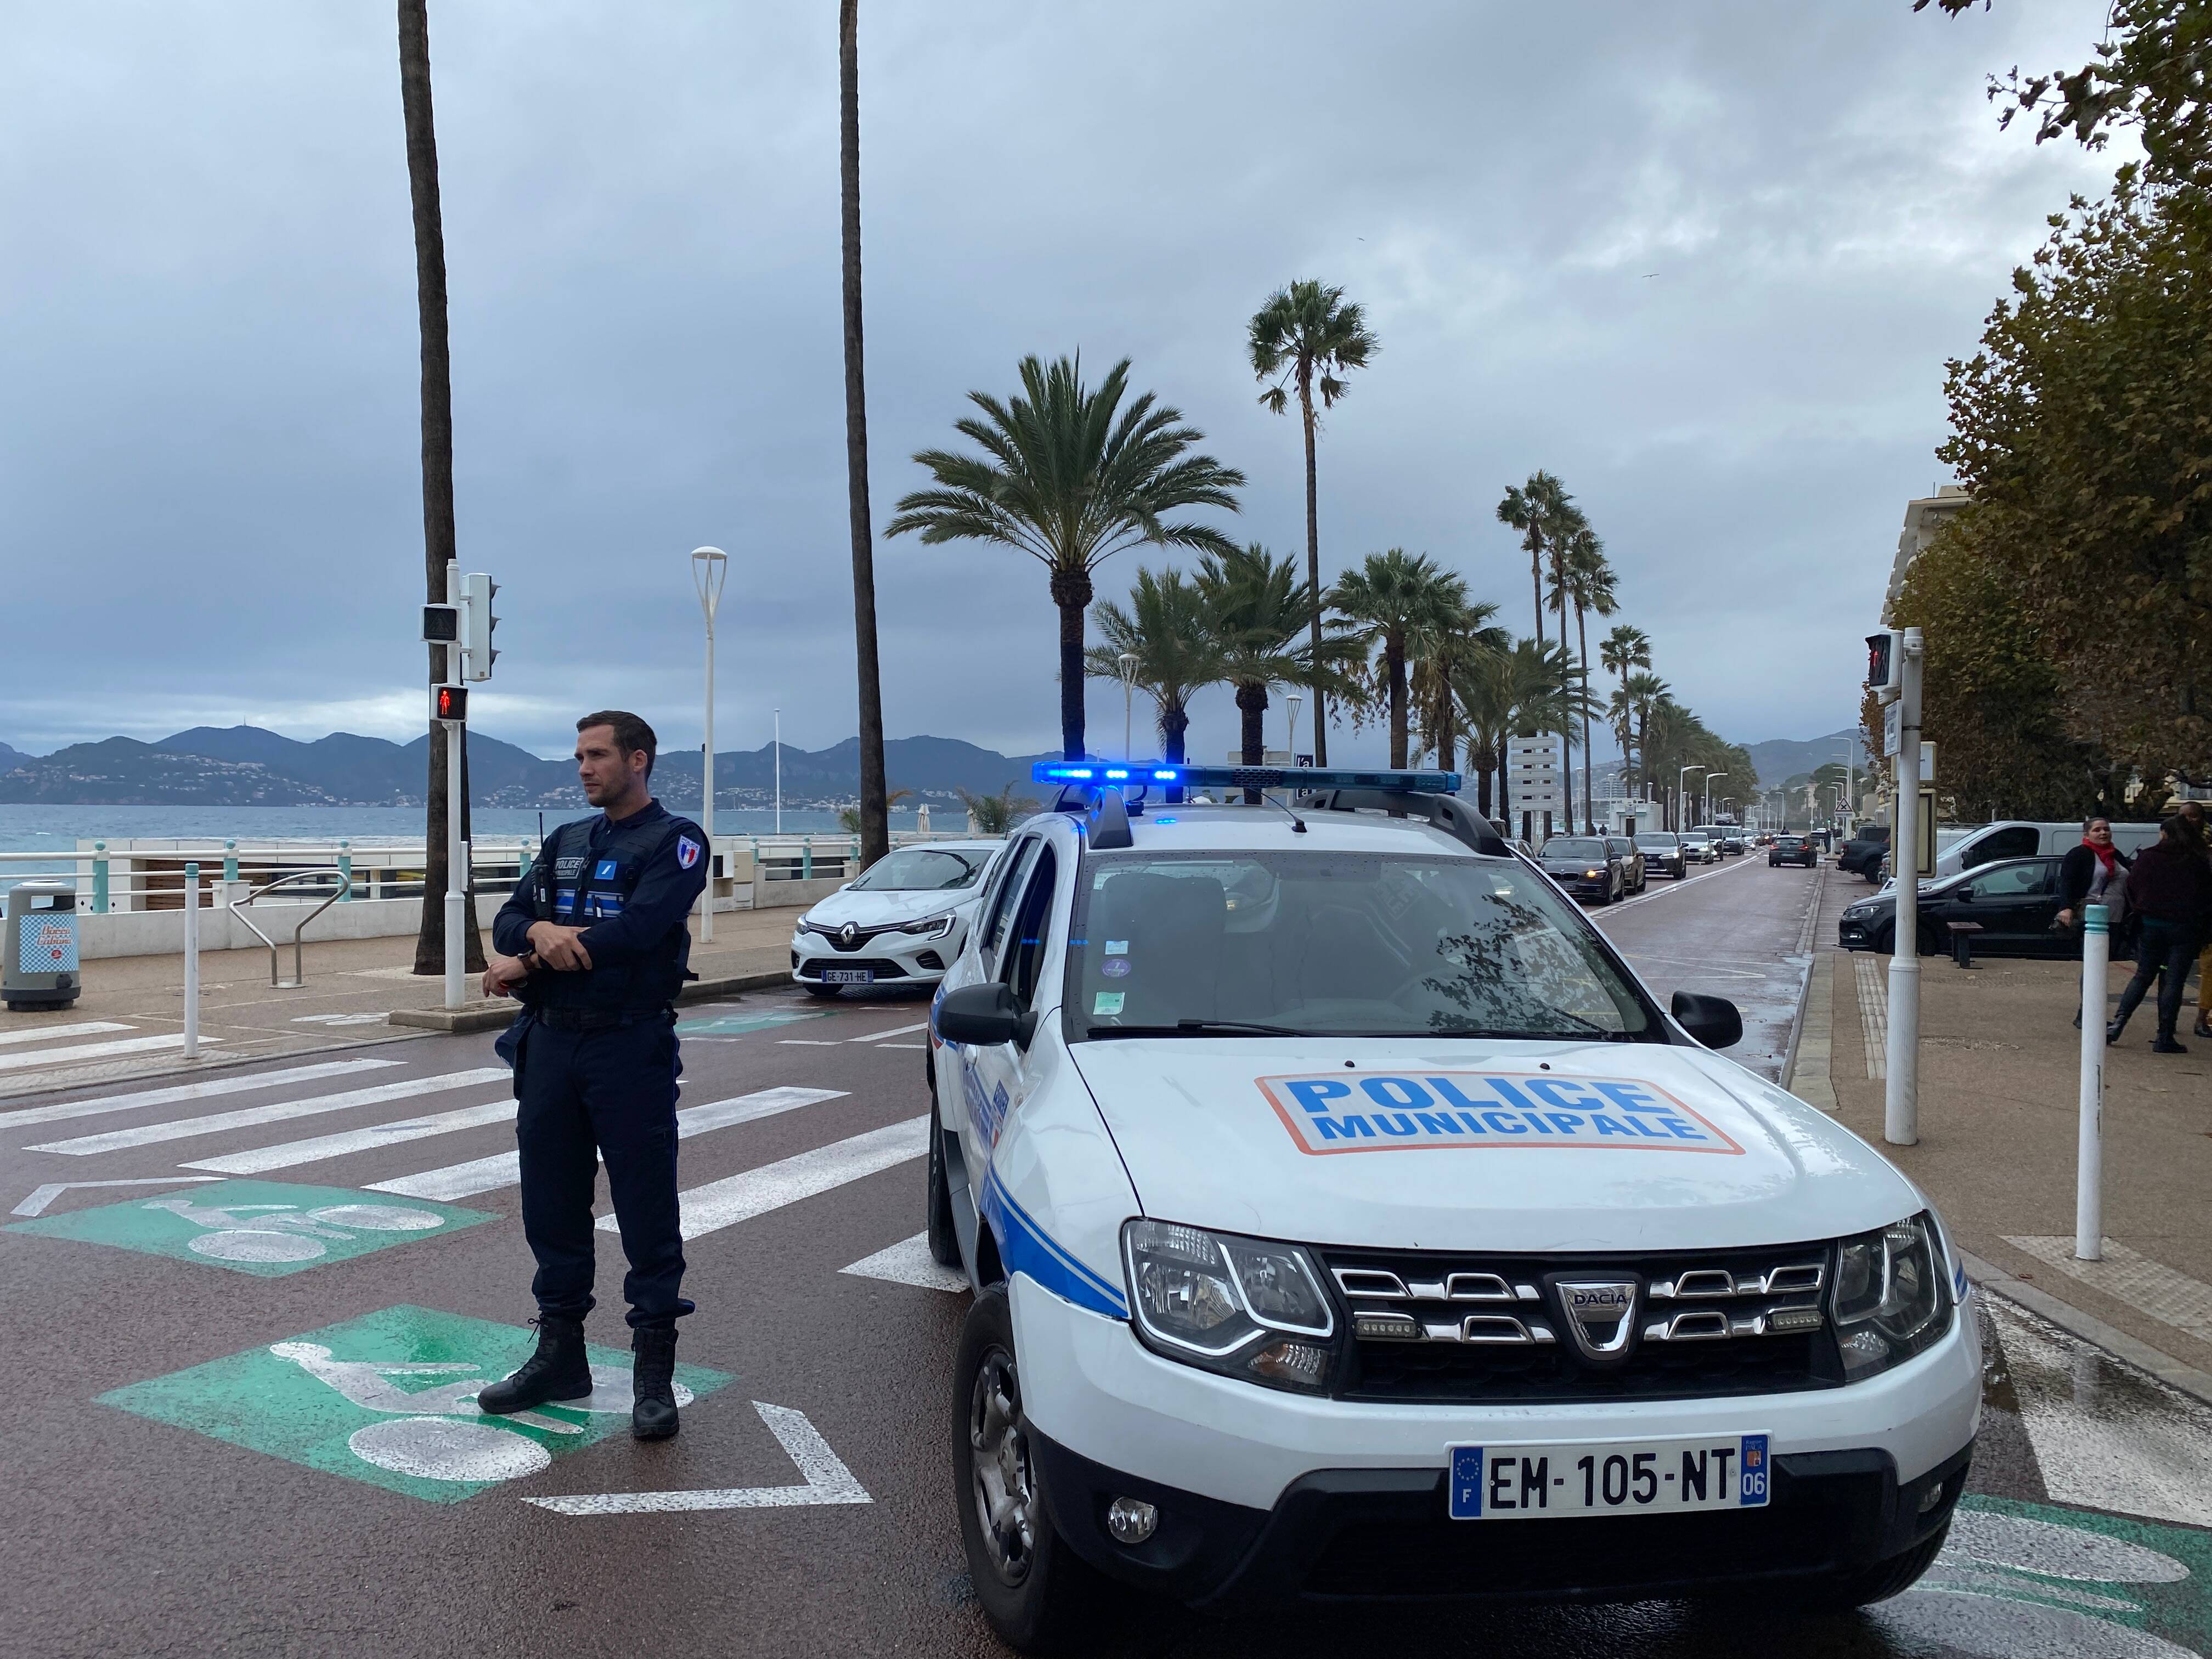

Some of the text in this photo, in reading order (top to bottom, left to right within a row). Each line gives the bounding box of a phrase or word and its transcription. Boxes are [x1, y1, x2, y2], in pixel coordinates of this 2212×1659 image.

[555, 860, 581, 870] POLICE
[1284, 1077, 1679, 1117] POLICE
[1311, 1112, 1708, 1140] MUNICIPALE
[1574, 1294, 1628, 1305] DACIA
[1489, 1447, 1735, 1509] EM-105-NT
[1742, 1472, 1765, 1496] 06
[1463, 1488, 1472, 1503] F
